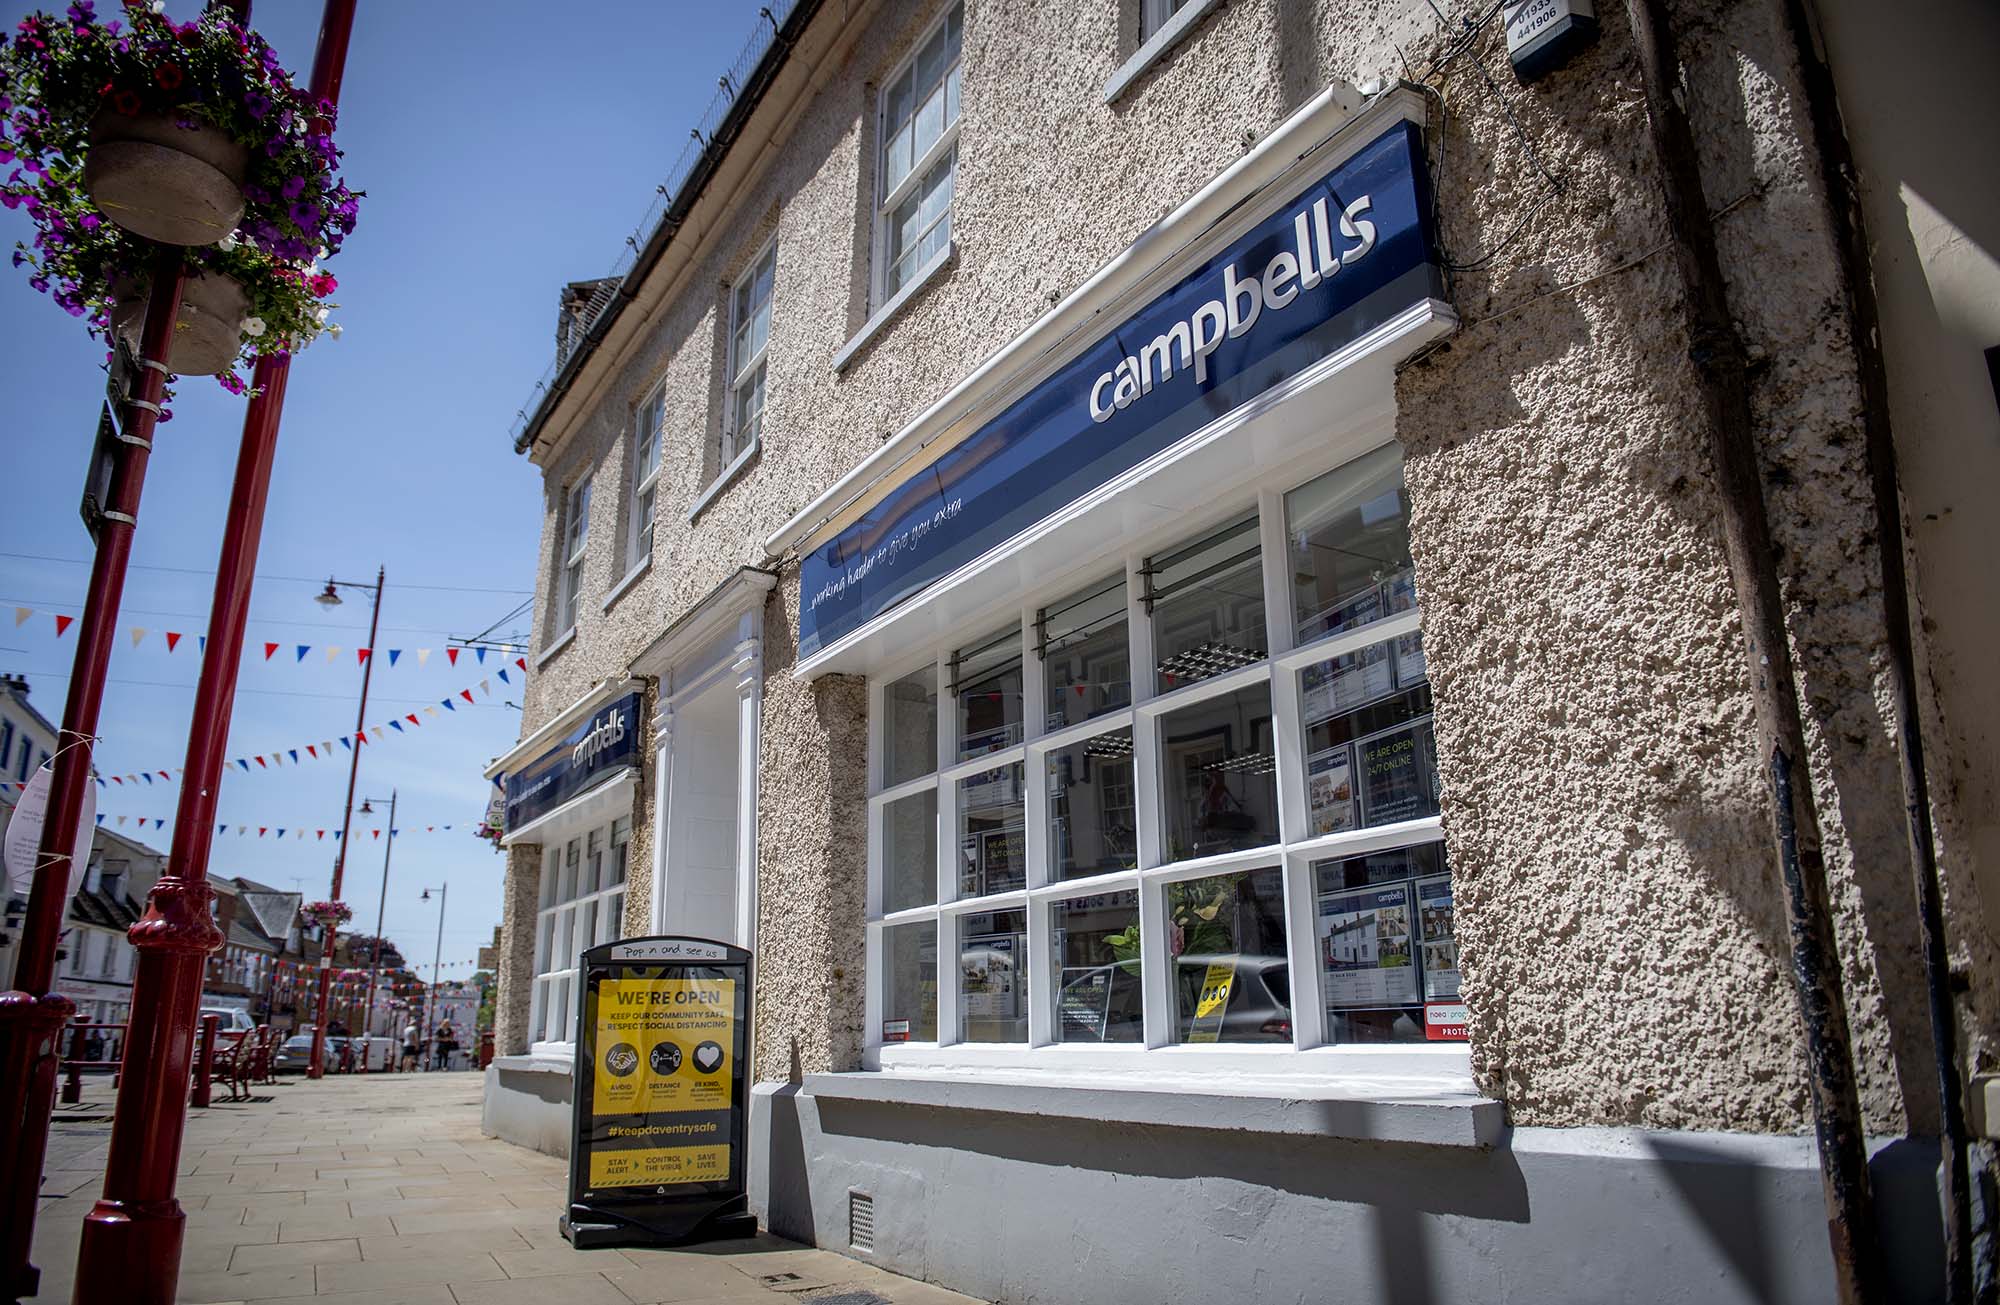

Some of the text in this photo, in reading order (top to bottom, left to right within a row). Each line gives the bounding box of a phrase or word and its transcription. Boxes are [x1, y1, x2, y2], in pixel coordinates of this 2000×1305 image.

[1517, 7, 1556, 40] 441906
[1089, 194, 1377, 424] campbells
[847, 554, 876, 586] harder
[877, 547, 887, 563] to
[889, 532, 909, 566] give
[911, 519, 931, 551] you
[933, 498, 962, 529] extra
[572, 708, 625, 769] campbells
[1363, 738, 1414, 762] WE ARE OPEN
[1383, 754, 1411, 771] ONLINE
[1378, 891, 1404, 903] campbells
[624, 946, 645, 958] Pop
[661, 944, 681, 954] and
[686, 947, 703, 956] see
[706, 949, 718, 958] us
[617, 990, 720, 1005] WE'RE OPEN
[610, 1011, 725, 1020] KEEP OUR COMMUNITY SAFE
[1429, 1010, 1467, 1019] naea prop
[607, 1020, 728, 1030] RESPECT SOCIAL DISTANCING
[1442, 1028, 1468, 1036] PROTE
[648, 1082, 681, 1090] DISTANCE
[607, 1122, 717, 1137] #keepdaventrysafe
[645, 1155, 682, 1164] CONTROL
[697, 1153, 716, 1161] SAVE
[608, 1158, 628, 1167] STAY
[645, 1163, 682, 1172] THE VIRUS
[696, 1161, 716, 1169] LIVES
[606, 1166, 629, 1175] ALERT
